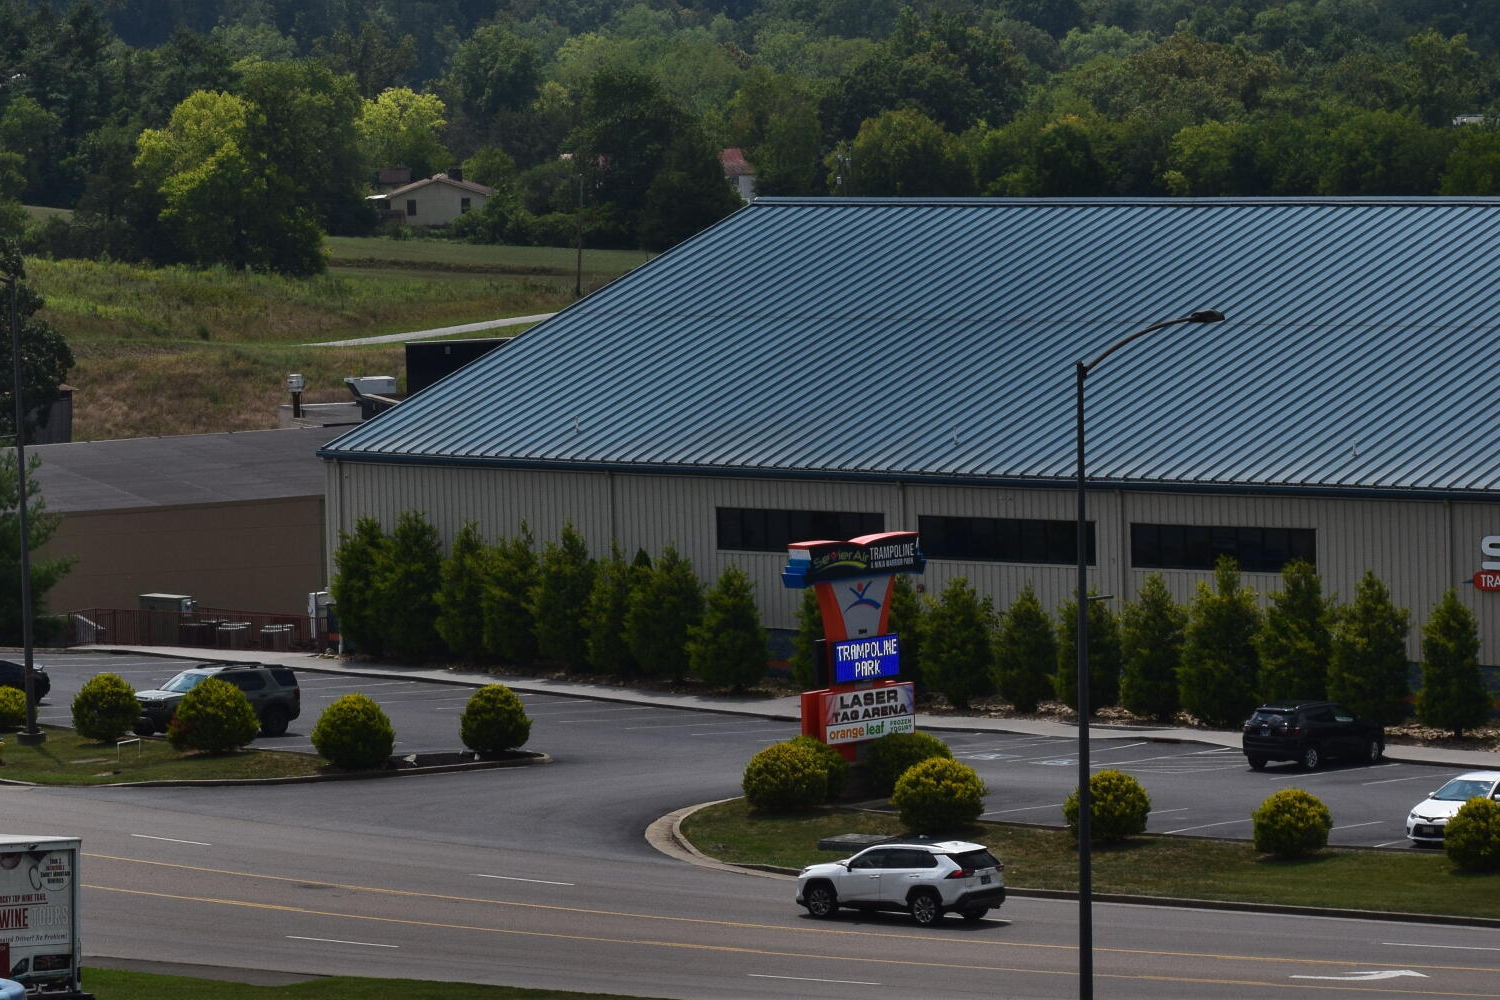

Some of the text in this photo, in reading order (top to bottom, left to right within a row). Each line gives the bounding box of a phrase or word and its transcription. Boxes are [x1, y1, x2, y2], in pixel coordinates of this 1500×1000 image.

[870, 542, 915, 560] TRAMPOLINE
[836, 638, 897, 661] TRAMPOLINE
[855, 659, 881, 677] PARK
[839, 689, 899, 709] LASER
[832, 703, 908, 723] TAG ARENA
[829, 721, 885, 740] orange leaf
[12, 894, 21, 902] TOP
[21, 894, 33, 902] WINE
[31, 905, 69, 928] TOURS
